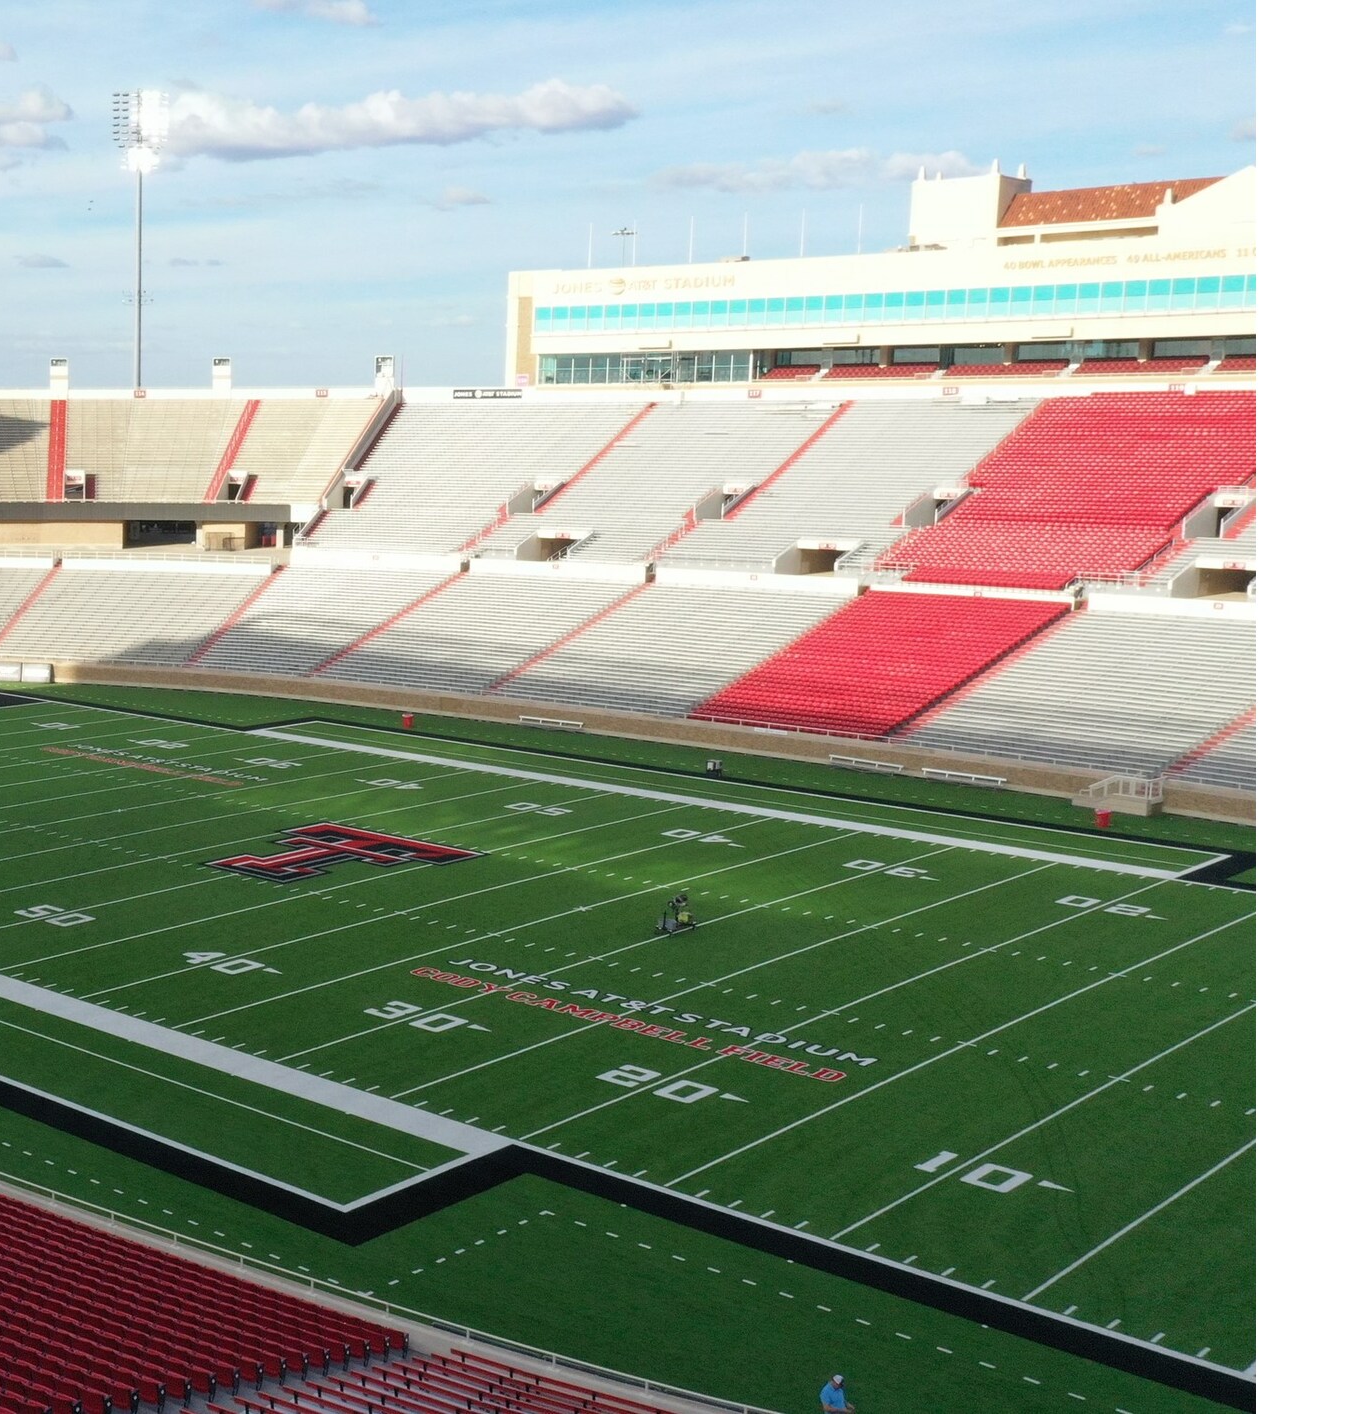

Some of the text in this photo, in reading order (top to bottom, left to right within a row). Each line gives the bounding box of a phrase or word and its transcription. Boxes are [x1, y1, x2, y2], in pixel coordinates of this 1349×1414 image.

[1047, 256, 1117, 269] APPEARANCES
[664, 275, 735, 291] STADIUM
[503, 802, 573, 817] 50
[661, 828, 730, 843] 40
[842, 859, 928, 878] 30
[14, 904, 96, 927] 50
[1055, 895, 1152, 917] 20
[182, 951, 265, 976] 40
[363, 1001, 468, 1033] 30
[448, 957, 878, 1068] JONES AT&T STADIUM
[410, 966, 847, 1083] CODY CAMPBELL FIELD
[596, 1064, 720, 1104] 20
[913, 1150, 1033, 1194] 10
